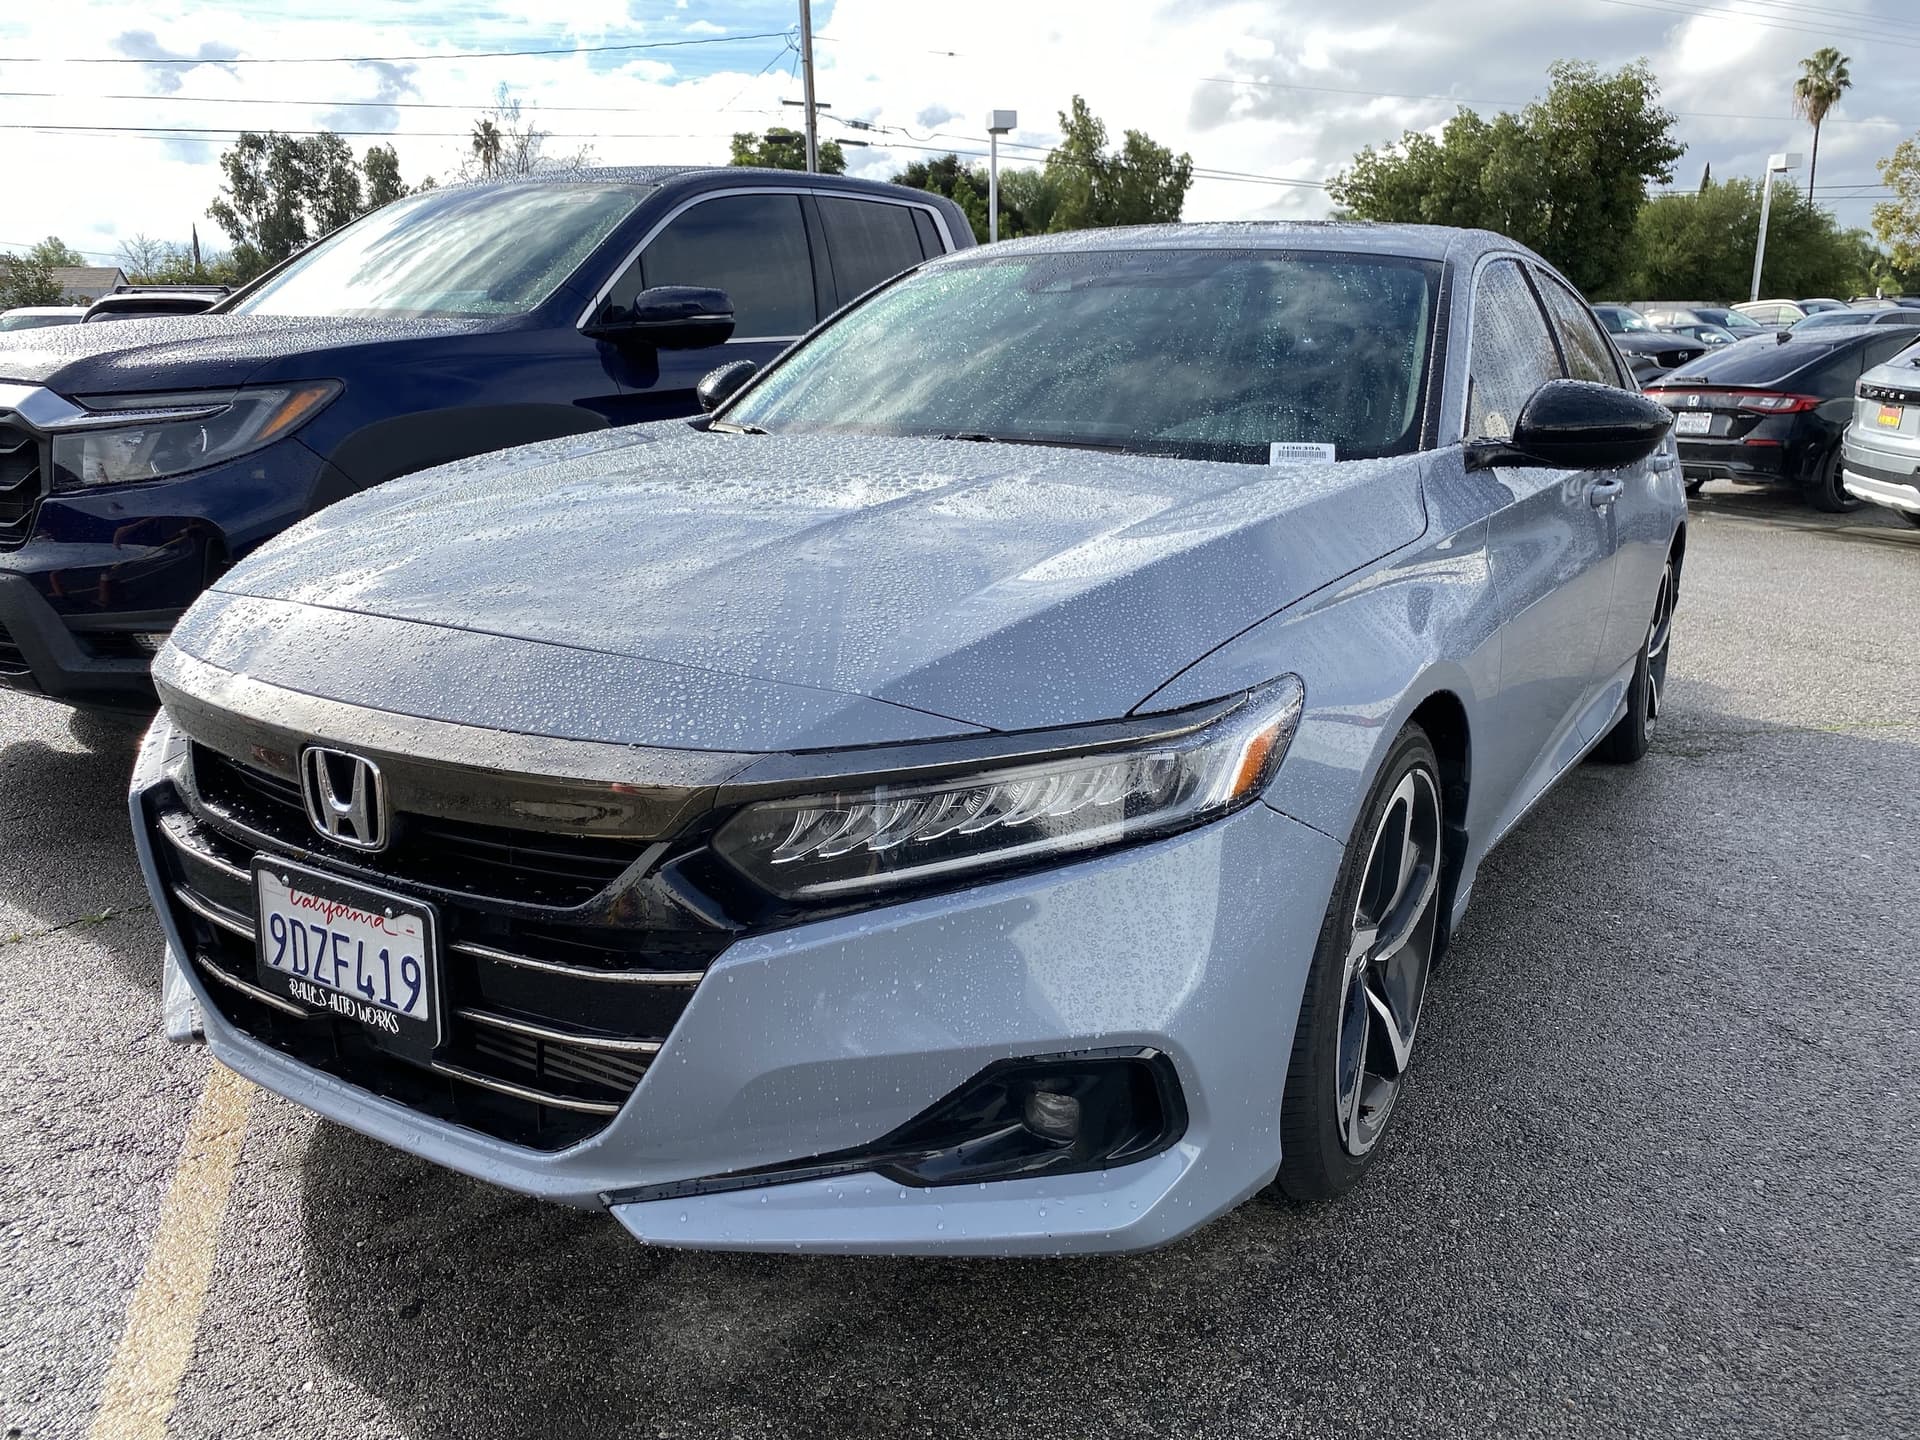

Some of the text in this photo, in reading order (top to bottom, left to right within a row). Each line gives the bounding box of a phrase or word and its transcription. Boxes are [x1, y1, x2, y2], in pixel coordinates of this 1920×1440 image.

[290, 888, 397, 936] California
[270, 913, 421, 1013] 9DZF419
[328, 993, 356, 1016] AUTO
[357, 1002, 400, 1034] WORKS
